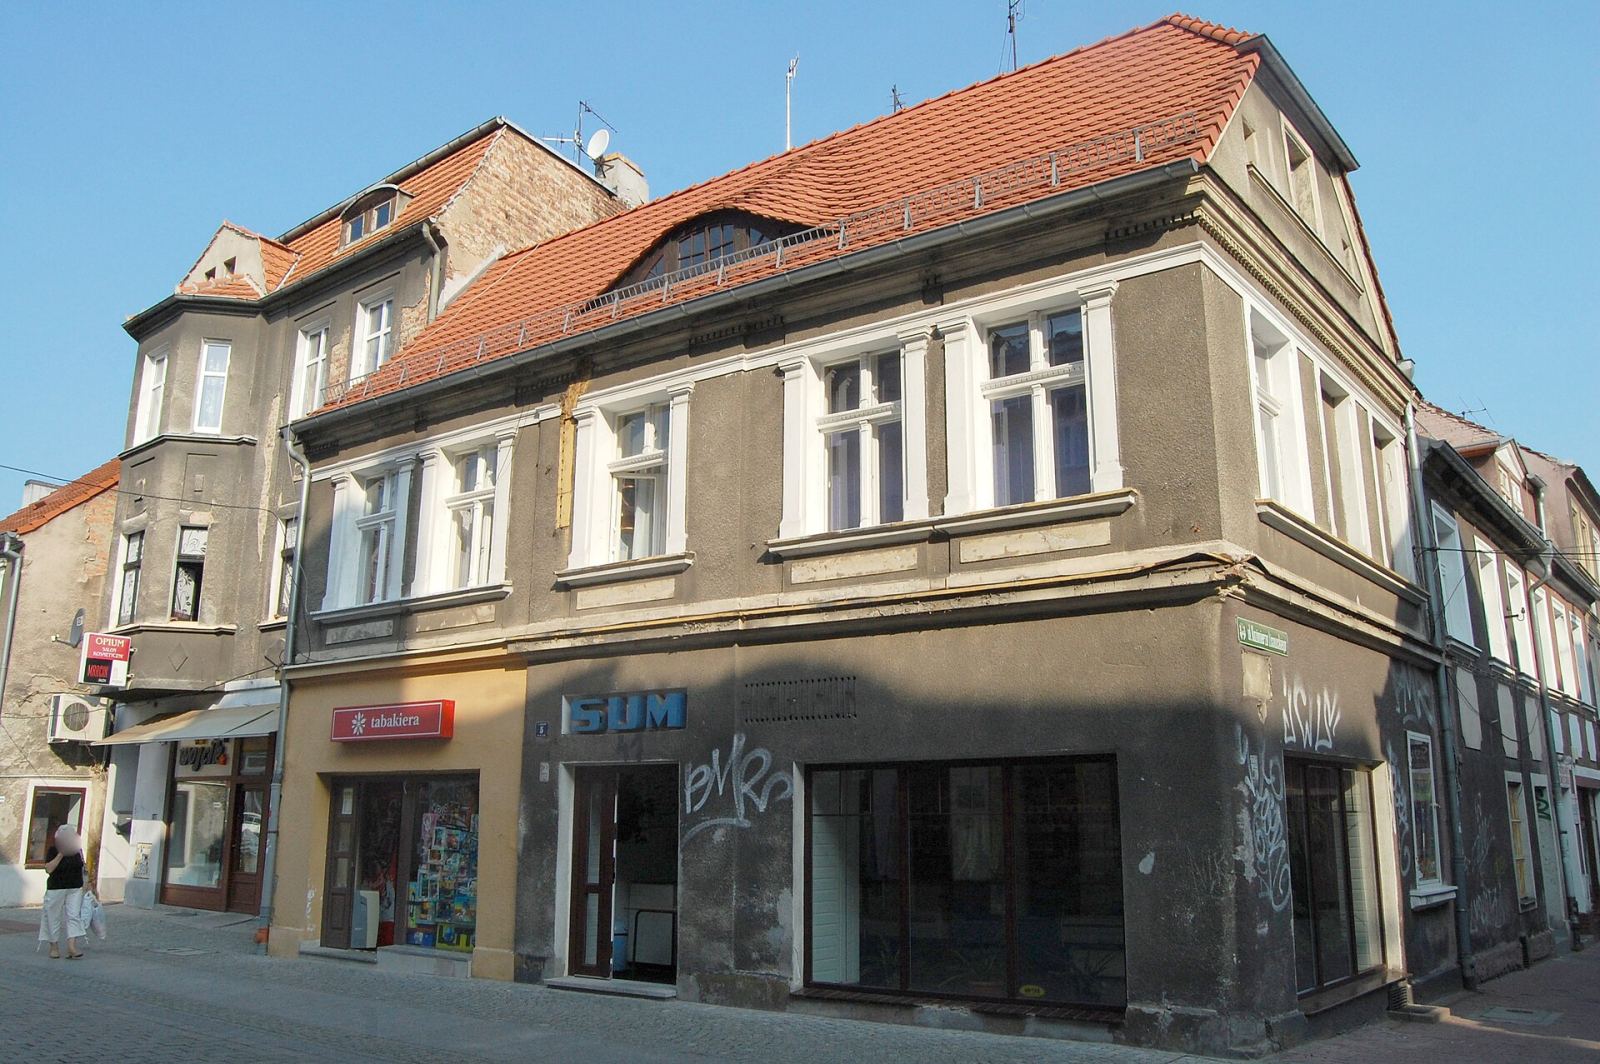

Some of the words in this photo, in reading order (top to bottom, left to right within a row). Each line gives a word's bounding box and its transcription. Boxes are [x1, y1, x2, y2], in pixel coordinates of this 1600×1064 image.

[95, 637, 125, 647] OPIUM
[371, 712, 420, 728] tabakiera
[569, 692, 688, 733] SUM
